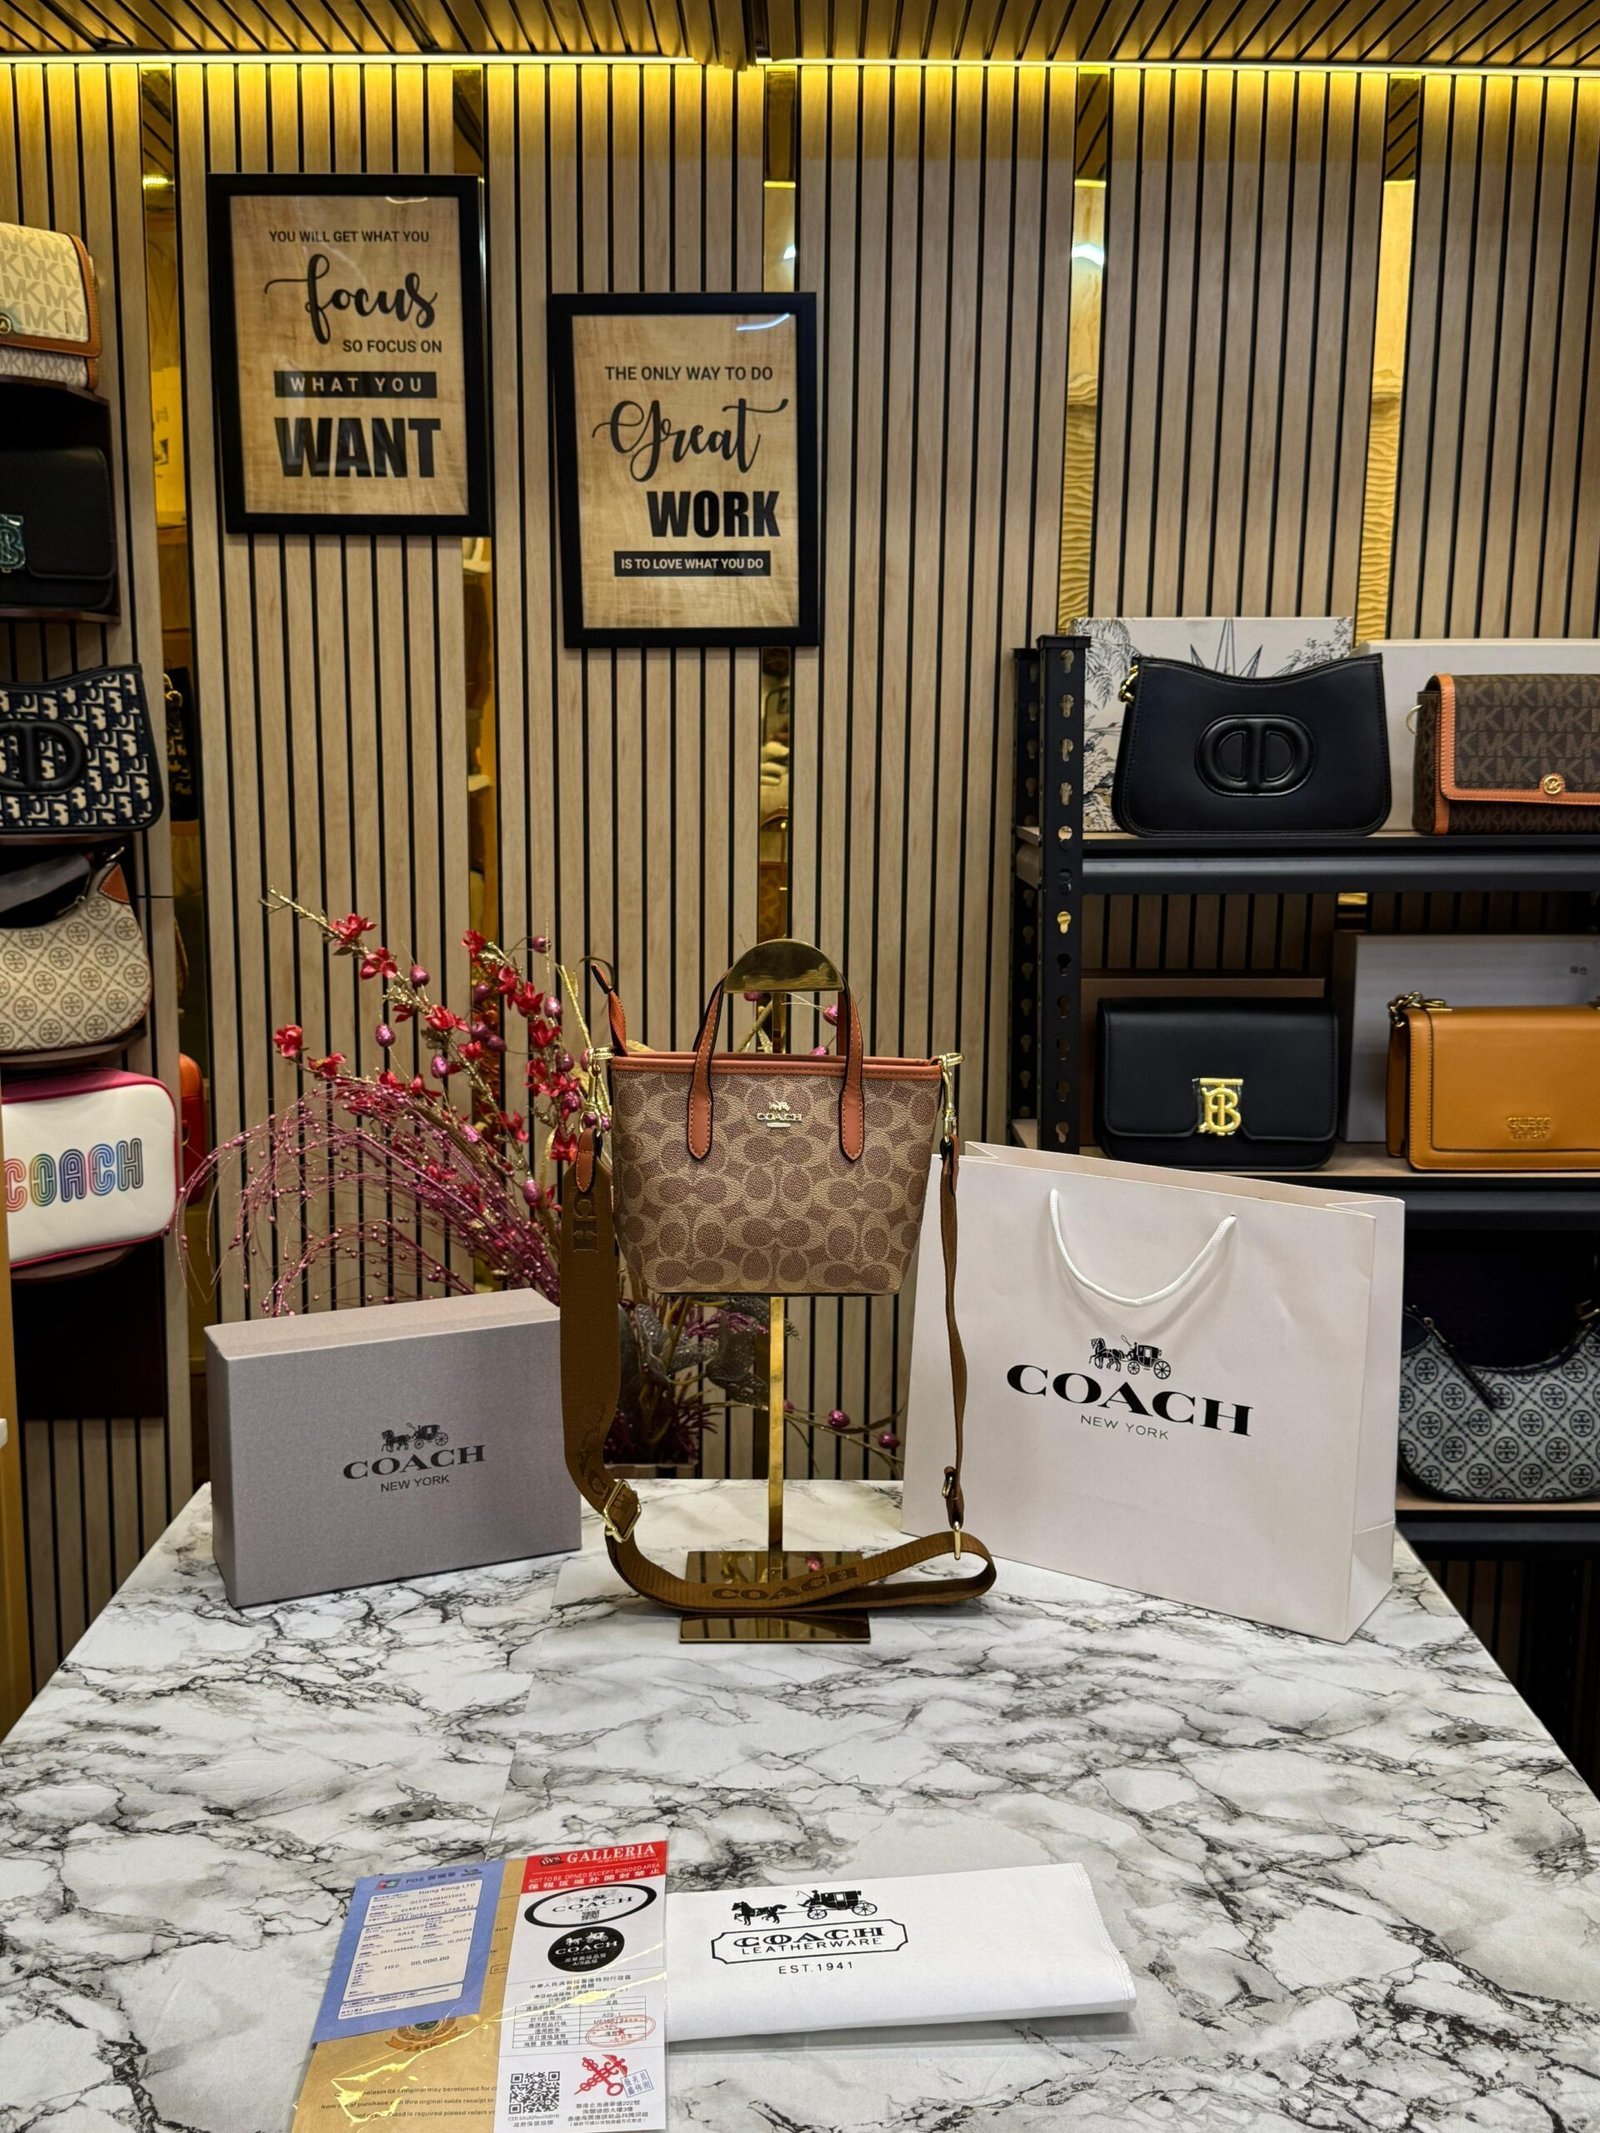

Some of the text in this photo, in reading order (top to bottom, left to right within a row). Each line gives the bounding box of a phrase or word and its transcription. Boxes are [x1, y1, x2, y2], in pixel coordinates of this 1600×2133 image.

[269, 231, 430, 242] YOU WILL GET WHAT YOU
[264, 254, 438, 345] focus
[342, 340, 442, 353] SO FOCUS ON
[605, 366, 773, 381] THE ONLY WAY TO DO
[290, 377, 422, 392] WHAT YOU
[274, 417, 441, 478] WANT
[591, 398, 789, 483] Great
[646, 490, 781, 538] WORK
[621, 558, 764, 570] IS TO LOVE WHAT YOU DO
[757, 1112, 802, 1121] COACH
[4, 1137, 144, 1212] COACH
[1006, 1364, 1254, 1437] COACH
[1080, 1414, 1169, 1441] NEW YORK
[343, 1444, 486, 1480] COACH
[380, 1474, 451, 1492] NEW YORK
[711, 1566, 859, 1601] COACH
[566, 1843, 656, 1864] GALLERIA
[588, 1869, 614, 1877] EXCEPT
[614, 1866, 642, 1874] BONDED
[552, 1896, 634, 1913] COACH
[733, 1927, 884, 1948] COACH
[741, 1938, 882, 1955] LEATHERWARE
[555, 1940, 618, 1955] COACH
